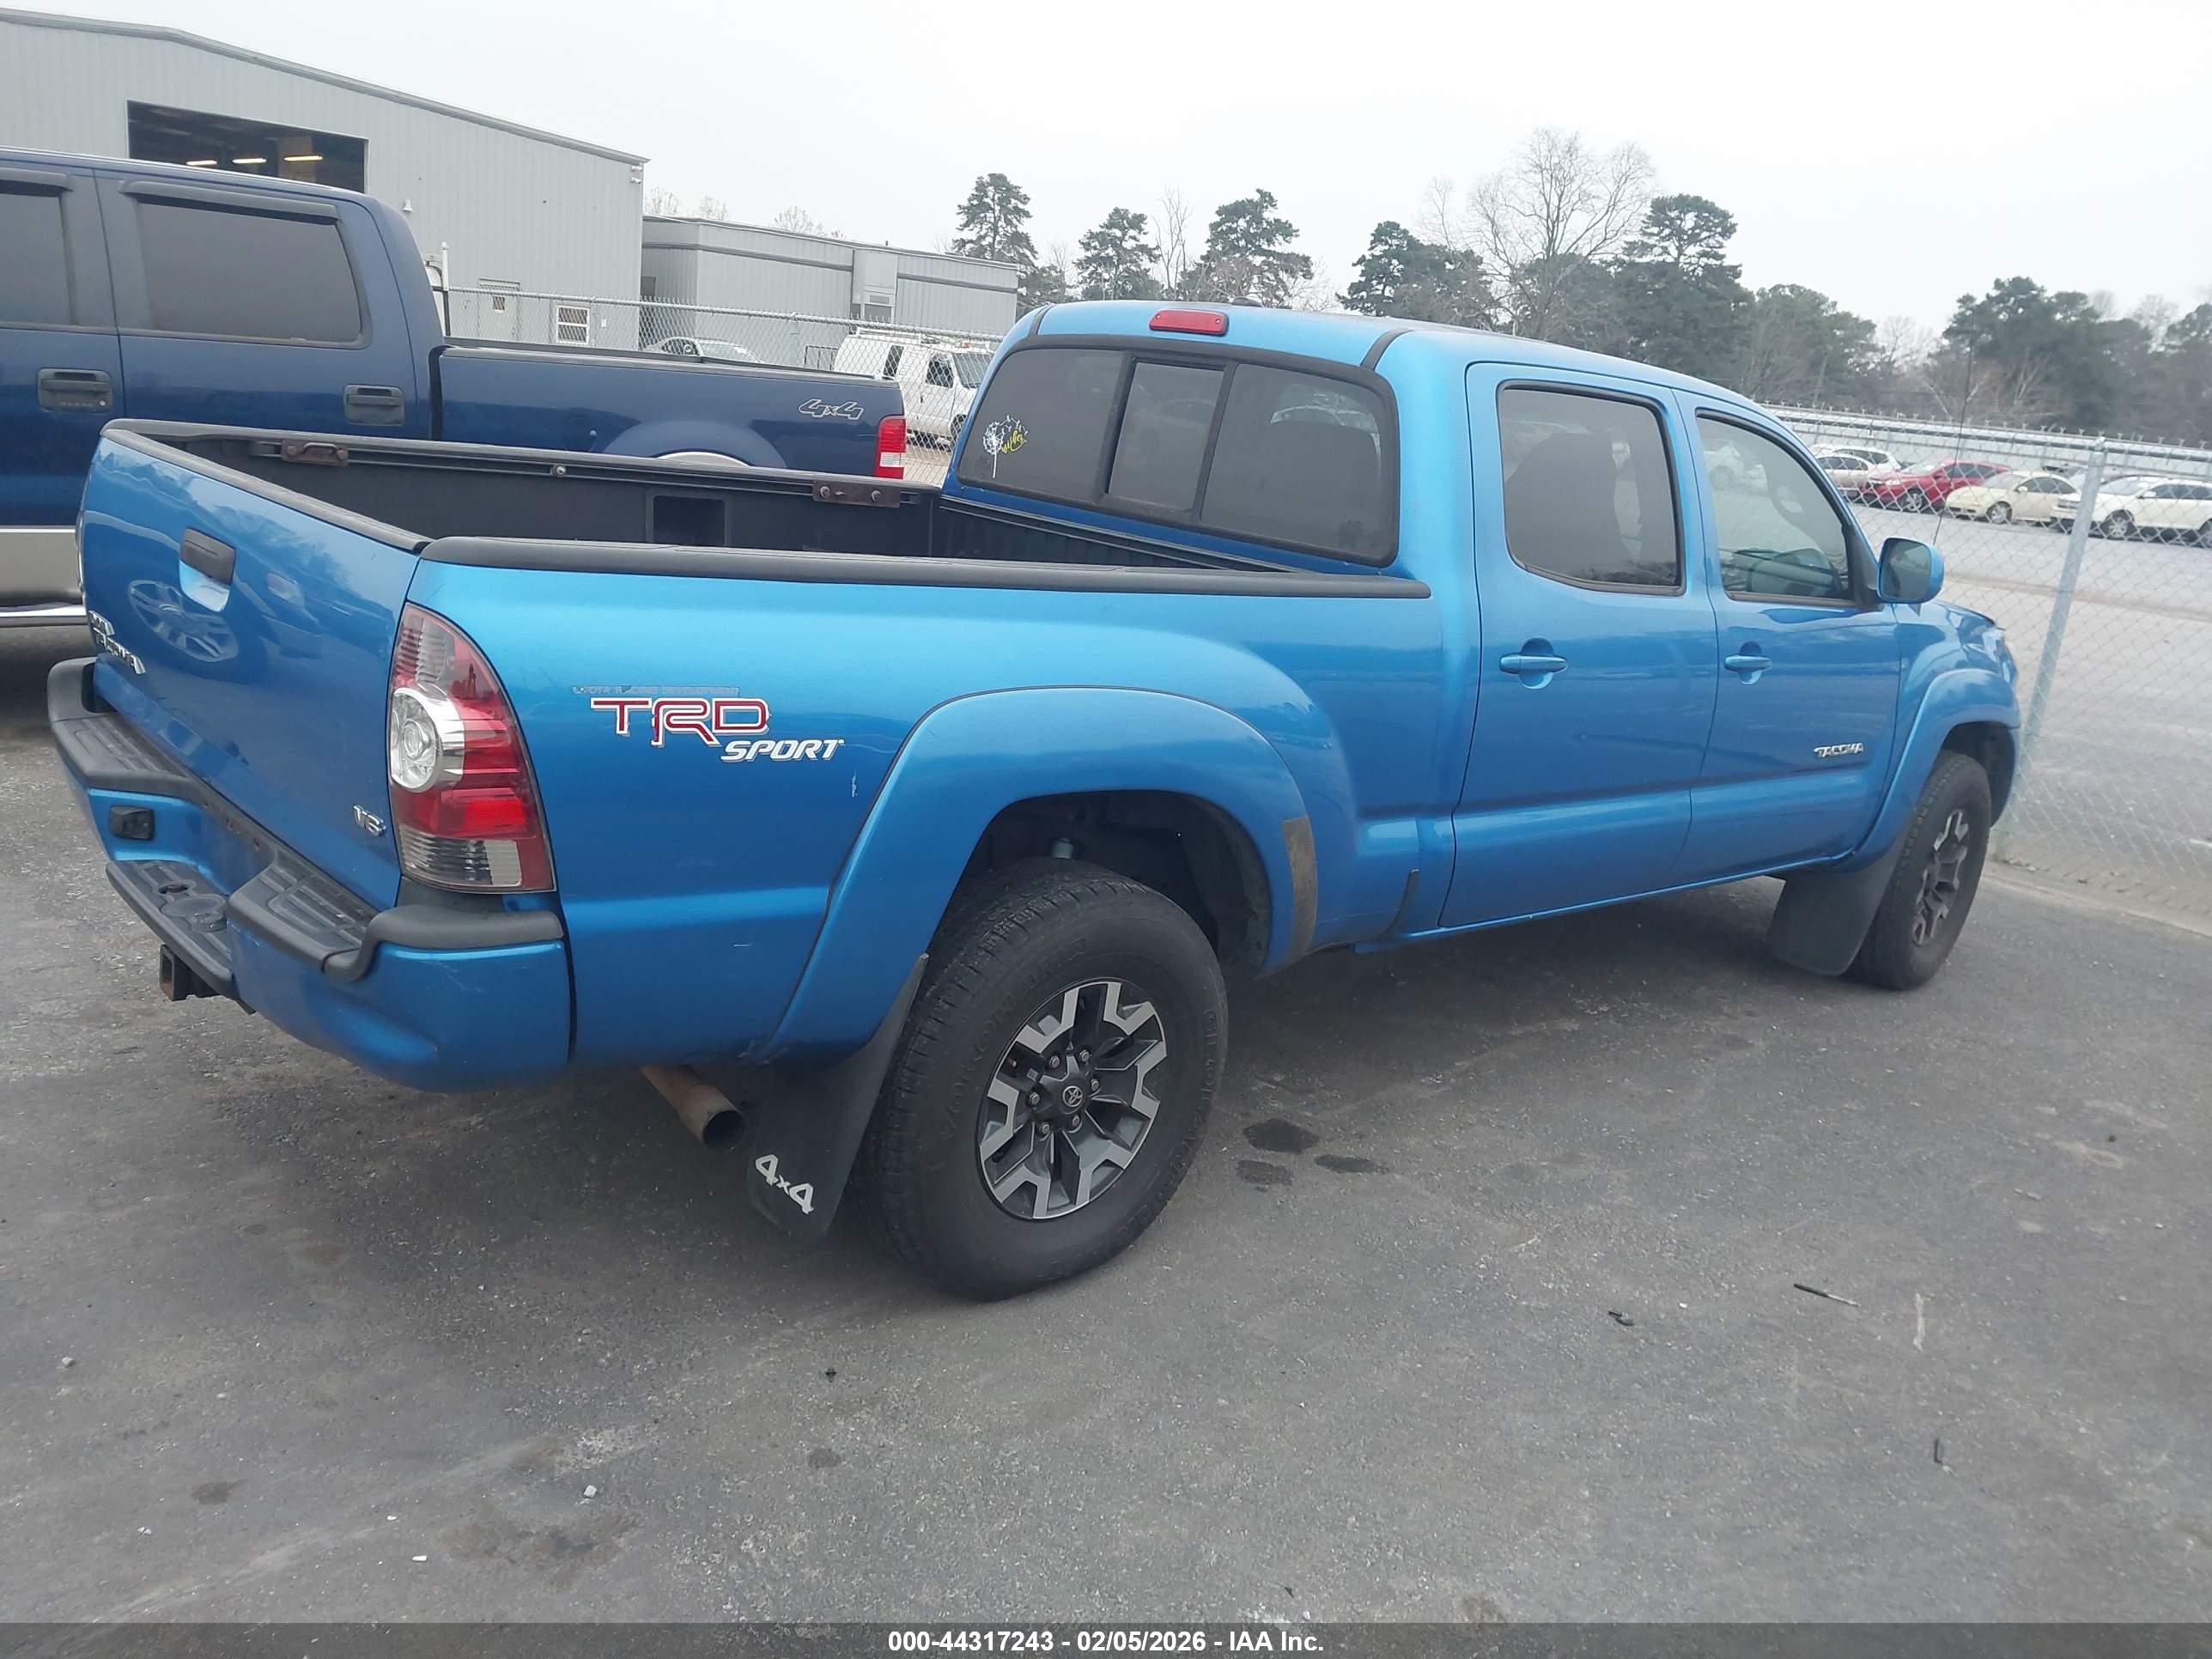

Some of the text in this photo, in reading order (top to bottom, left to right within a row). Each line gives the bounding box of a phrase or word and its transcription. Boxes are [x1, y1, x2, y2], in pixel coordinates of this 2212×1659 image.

[798, 398, 865, 421] 4x4
[590, 696, 771, 746] TRD
[720, 738, 846, 763] SPORT
[756, 1153, 815, 1215] 4x4
